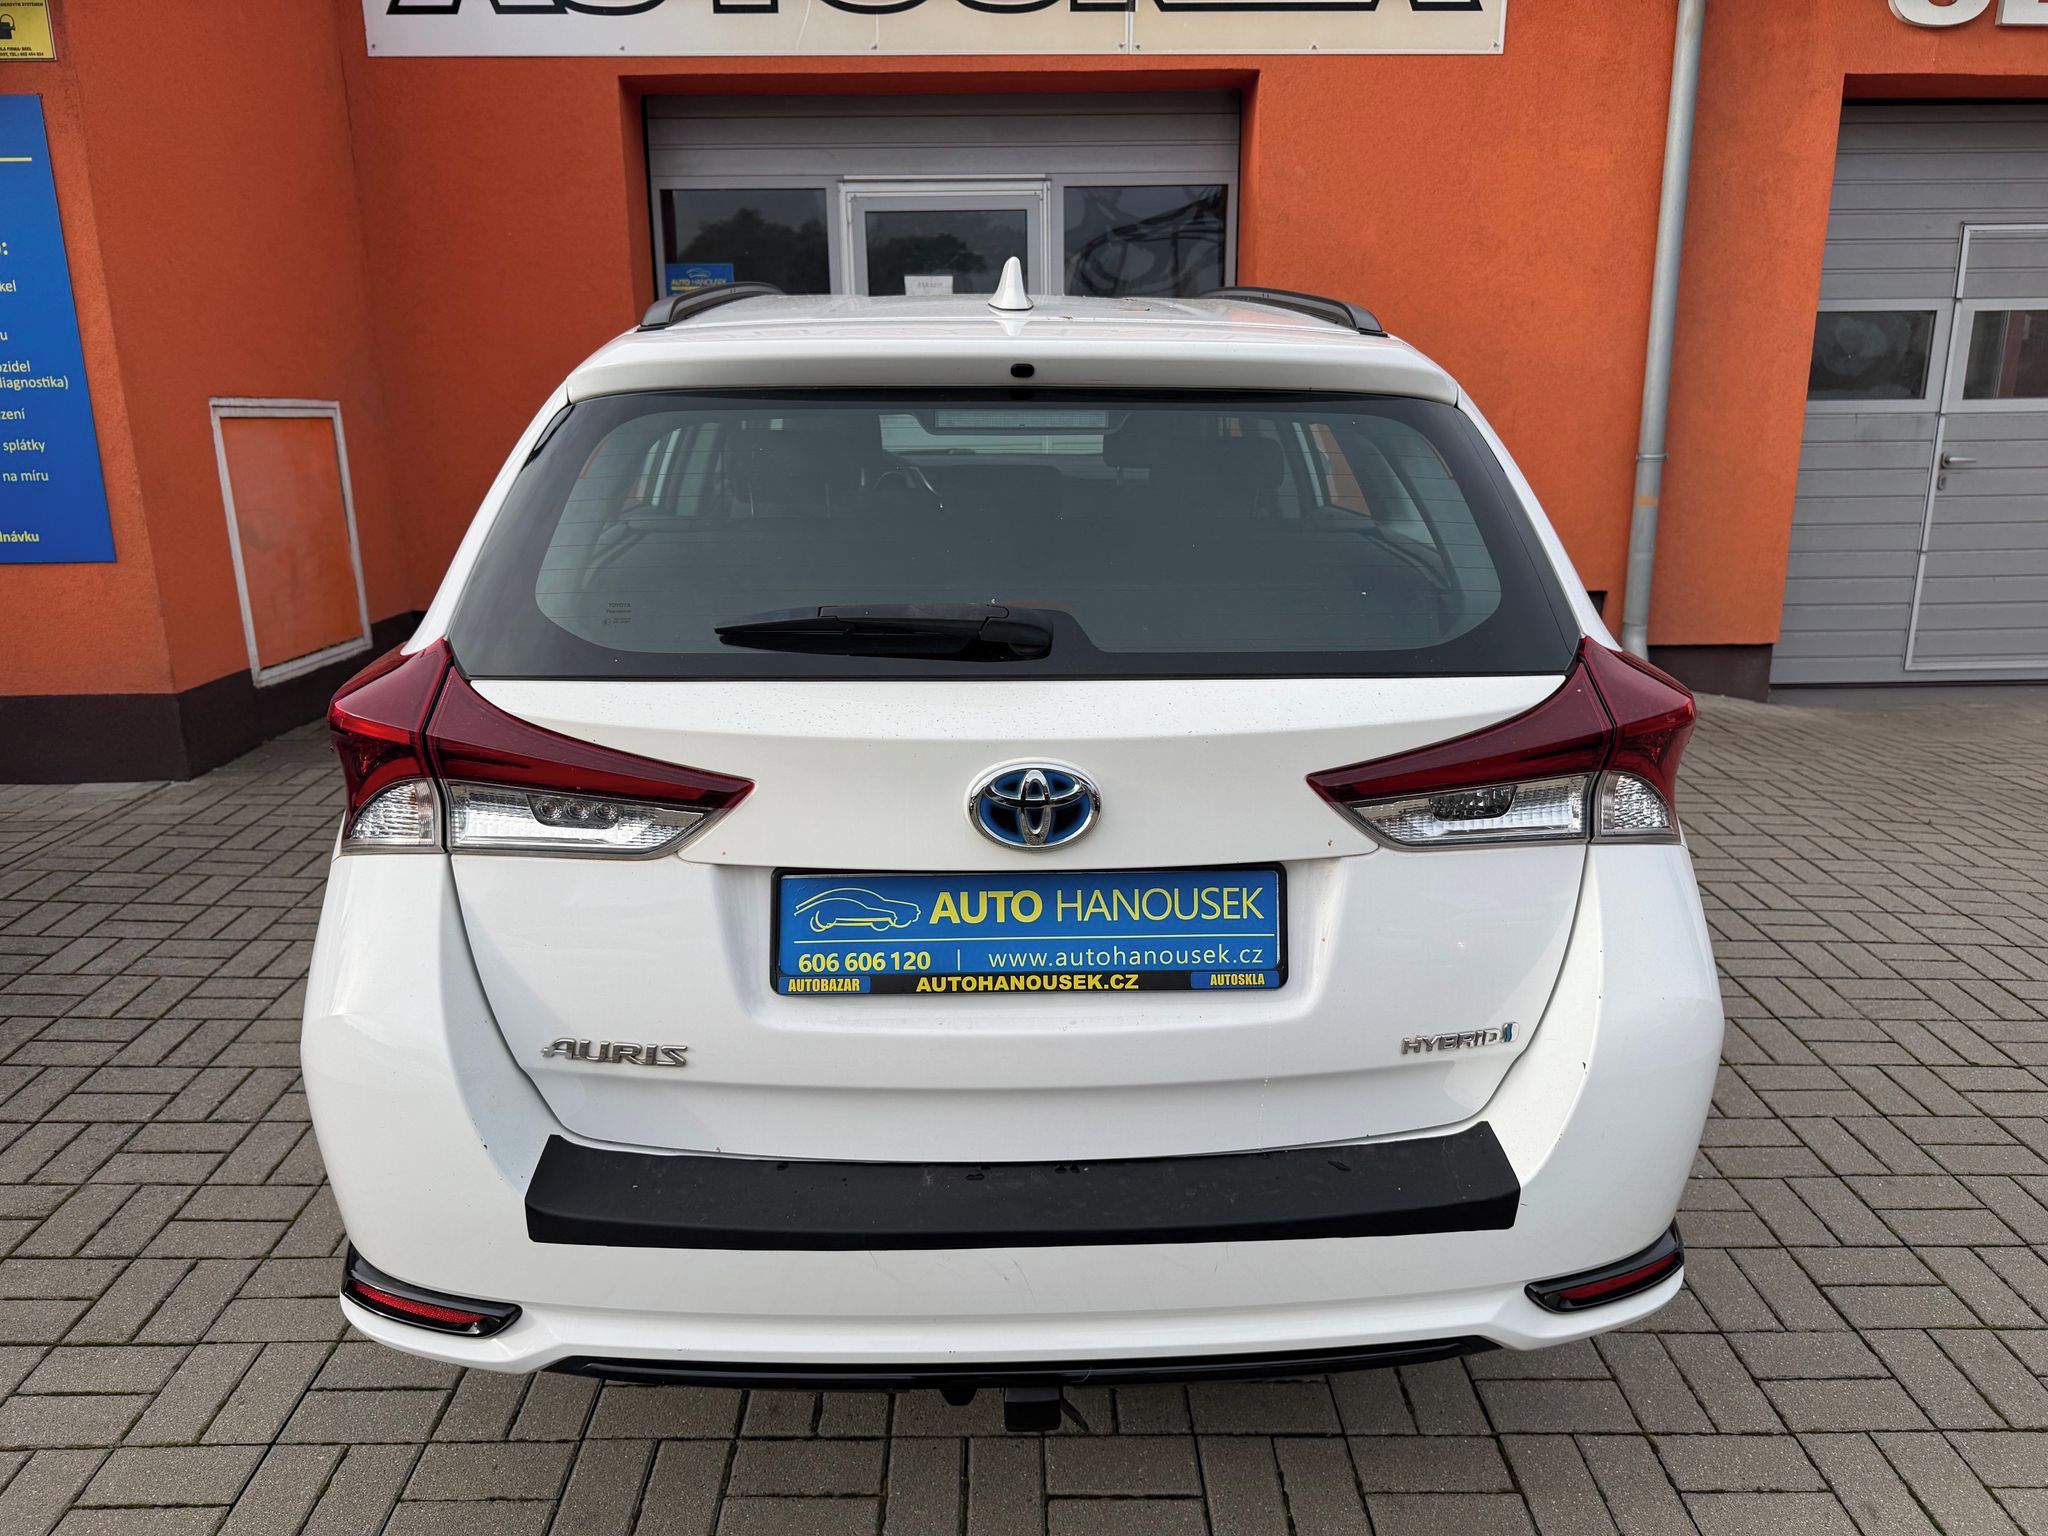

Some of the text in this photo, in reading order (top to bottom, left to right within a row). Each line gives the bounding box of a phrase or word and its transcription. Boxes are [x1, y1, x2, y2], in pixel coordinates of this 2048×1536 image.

[2, 439, 46, 454] splátky
[2, 469, 49, 482] na míru
[929, 887, 1265, 925] AUTO HANOUSEK
[798, 943, 1264, 973] 606 606 120 www.autohanousek.cz
[787, 973, 1265, 993] AUTOBAZAR AUTOHANOUSEK.CZ AUTOSKLA
[541, 1037, 688, 1067] AURIS
[1400, 1027, 1502, 1055] HYBRID
